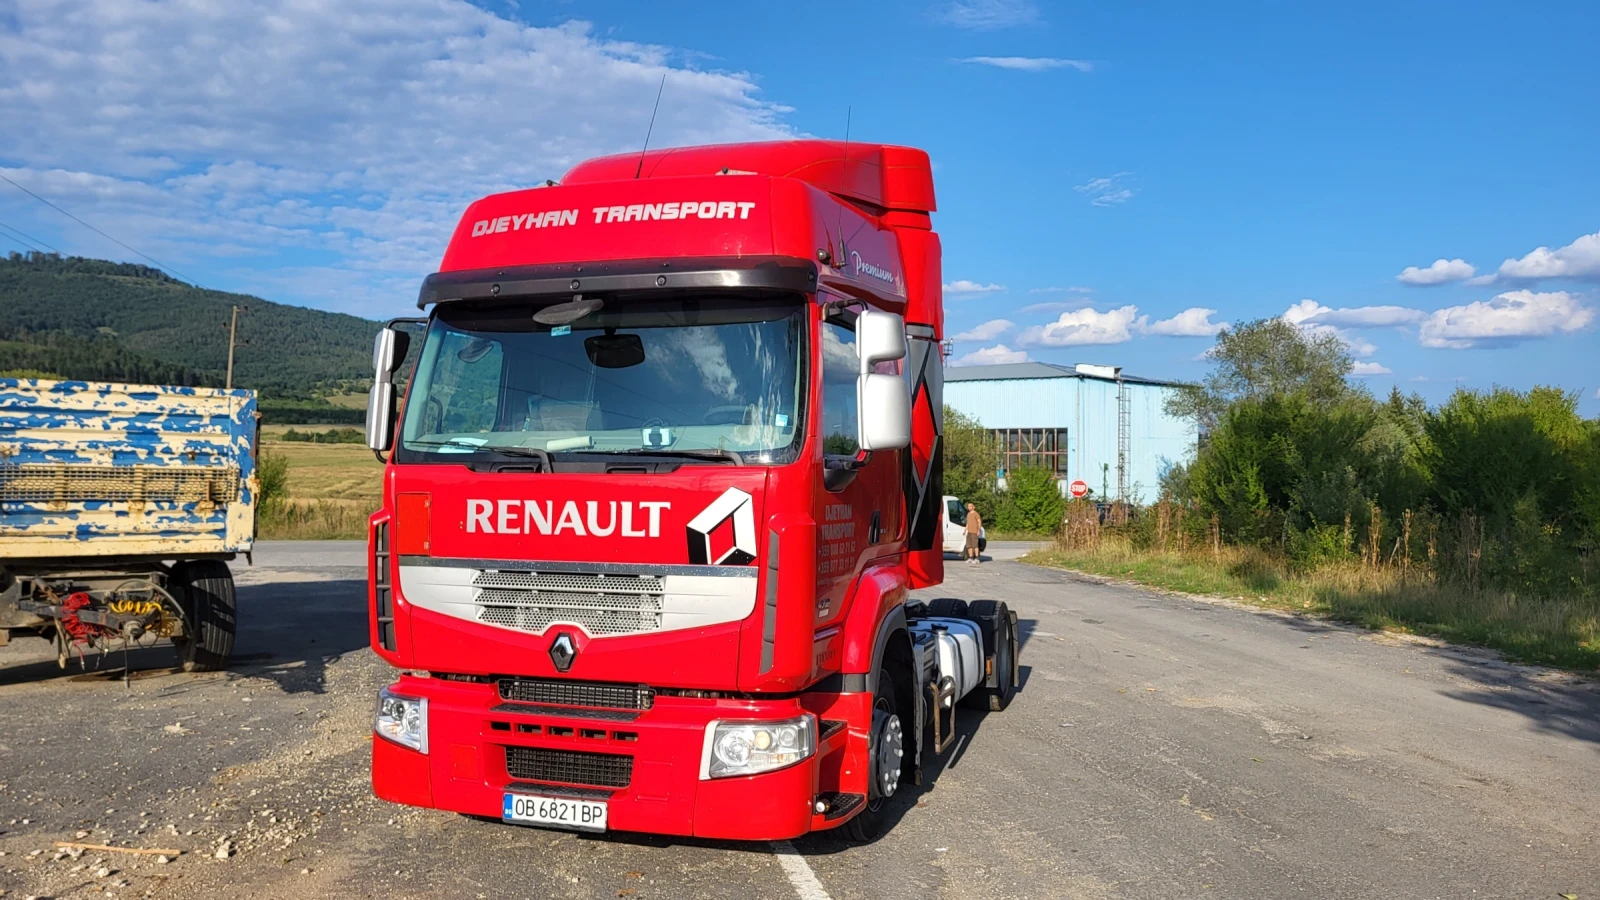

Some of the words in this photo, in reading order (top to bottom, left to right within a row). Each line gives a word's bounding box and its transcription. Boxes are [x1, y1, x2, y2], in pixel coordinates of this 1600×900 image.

[471, 208, 579, 237] DJEYHAN
[593, 201, 756, 224] TRANSPORT
[851, 250, 894, 283] Premium
[1071, 484, 1086, 492] STOP
[466, 499, 671, 537] RENAULT
[825, 504, 853, 521] DJEYHAN
[821, 522, 855, 540] TRANSPORT
[539, 801, 576, 822] 6821
[581, 805, 603, 823] BP
